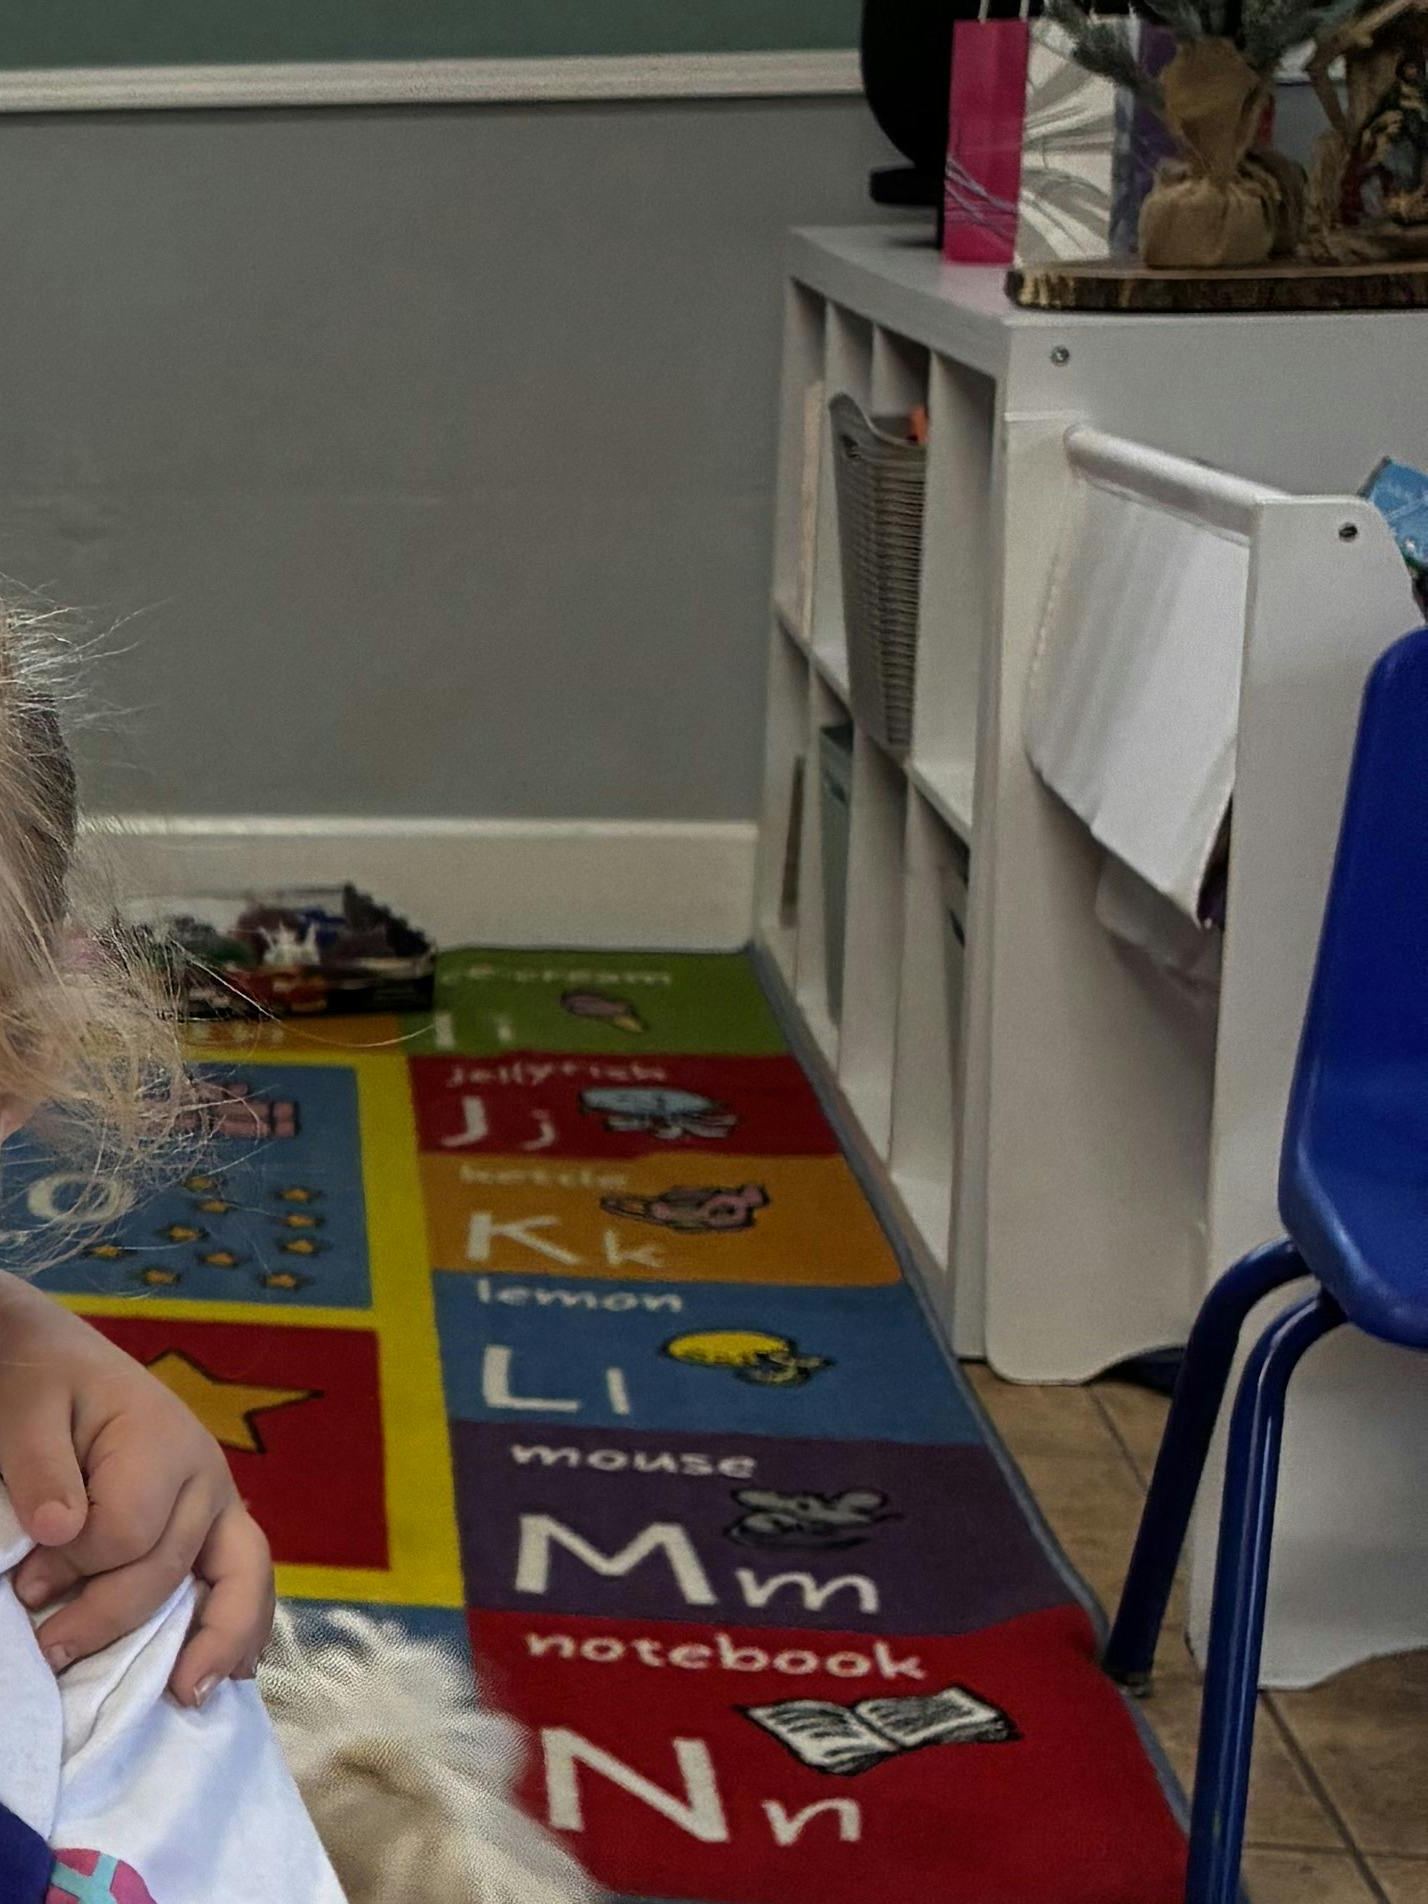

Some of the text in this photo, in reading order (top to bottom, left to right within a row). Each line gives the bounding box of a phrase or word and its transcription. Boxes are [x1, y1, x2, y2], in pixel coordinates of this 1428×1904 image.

[476, 1277, 684, 1314] lemon
[510, 1440, 759, 1481] mouse
[525, 1630, 929, 1682] notebook
